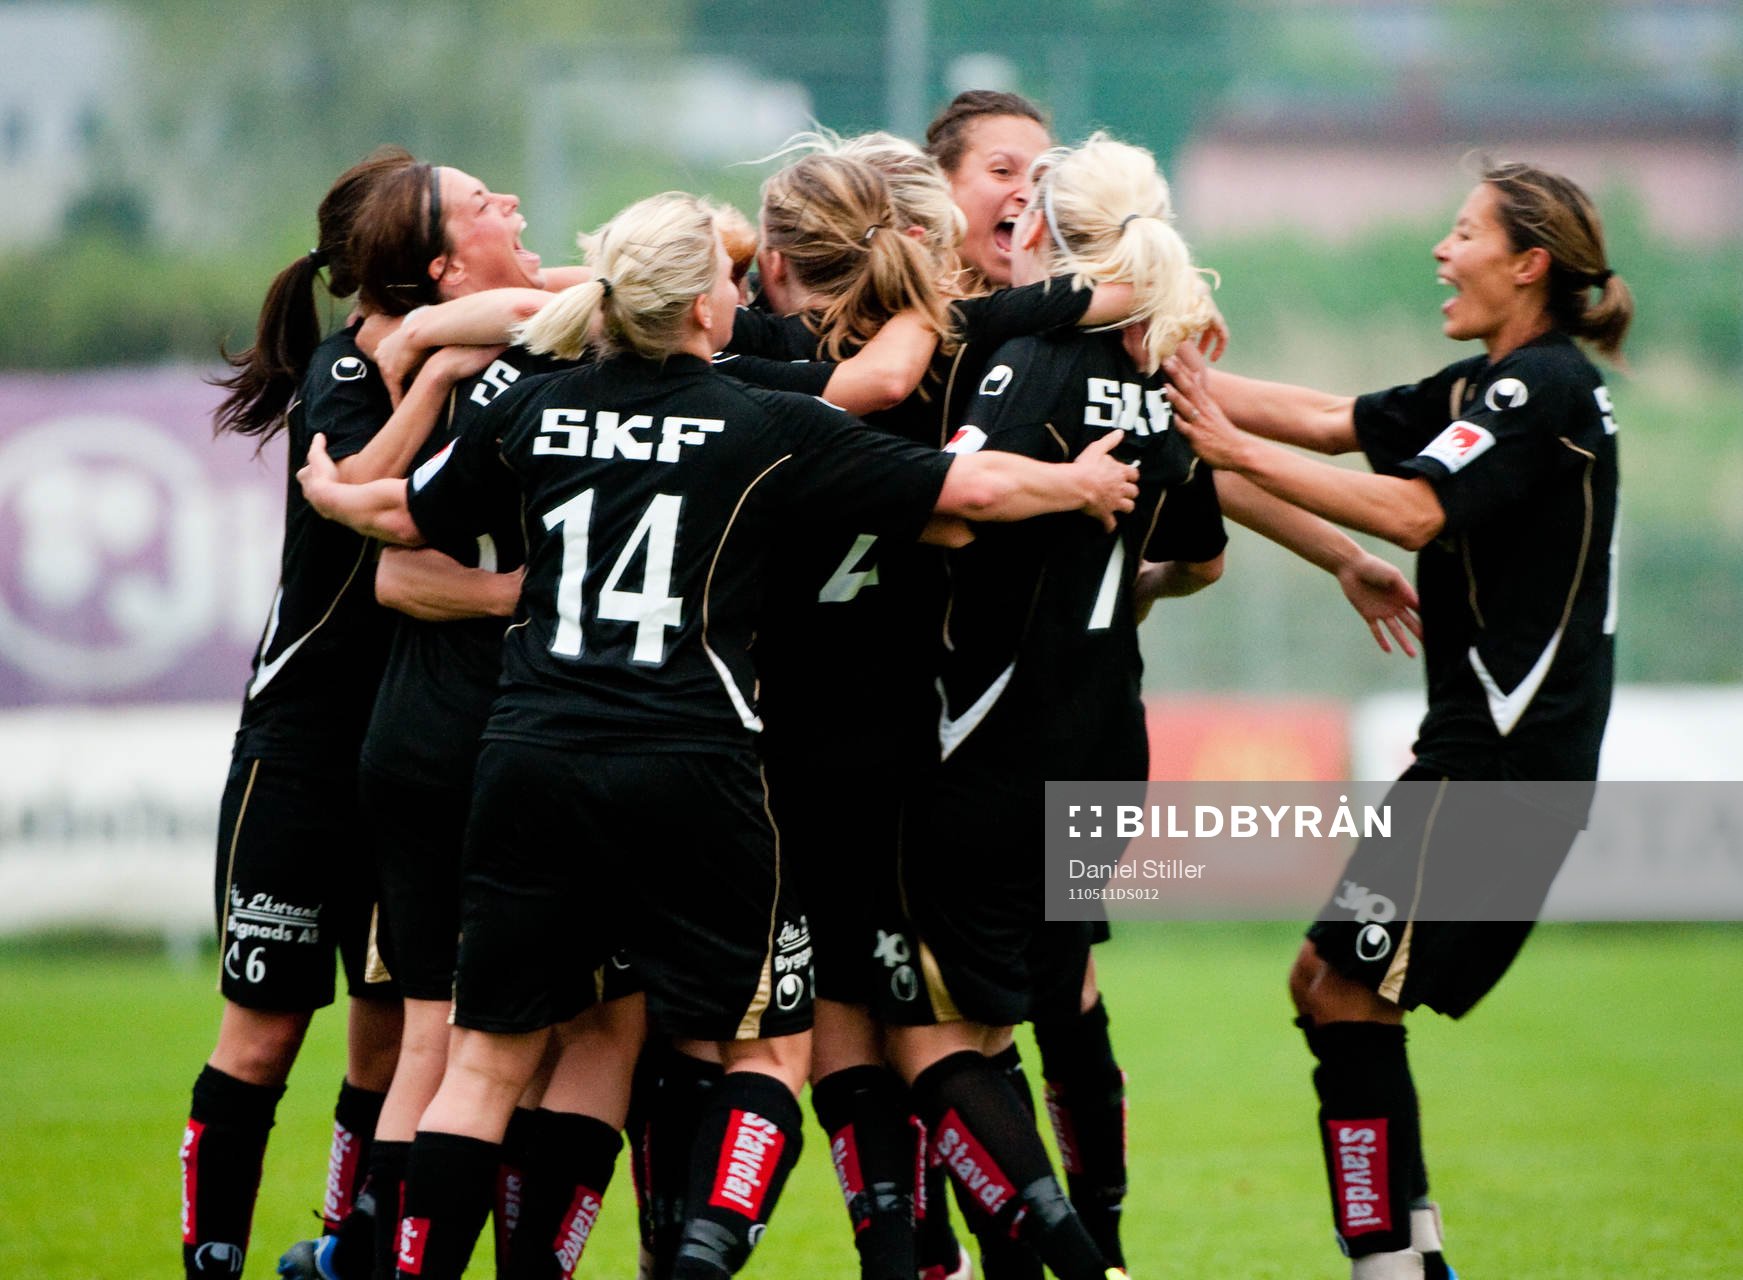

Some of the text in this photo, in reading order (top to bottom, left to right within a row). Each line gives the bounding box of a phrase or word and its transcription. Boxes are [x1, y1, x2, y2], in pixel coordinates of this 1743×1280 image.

[532, 408, 726, 463] SKF
[541, 487, 684, 664] 14
[721, 1111, 778, 1209] Stavdal
[1338, 1127, 1383, 1227] Stavdal
[554, 1195, 600, 1280] Stavda
